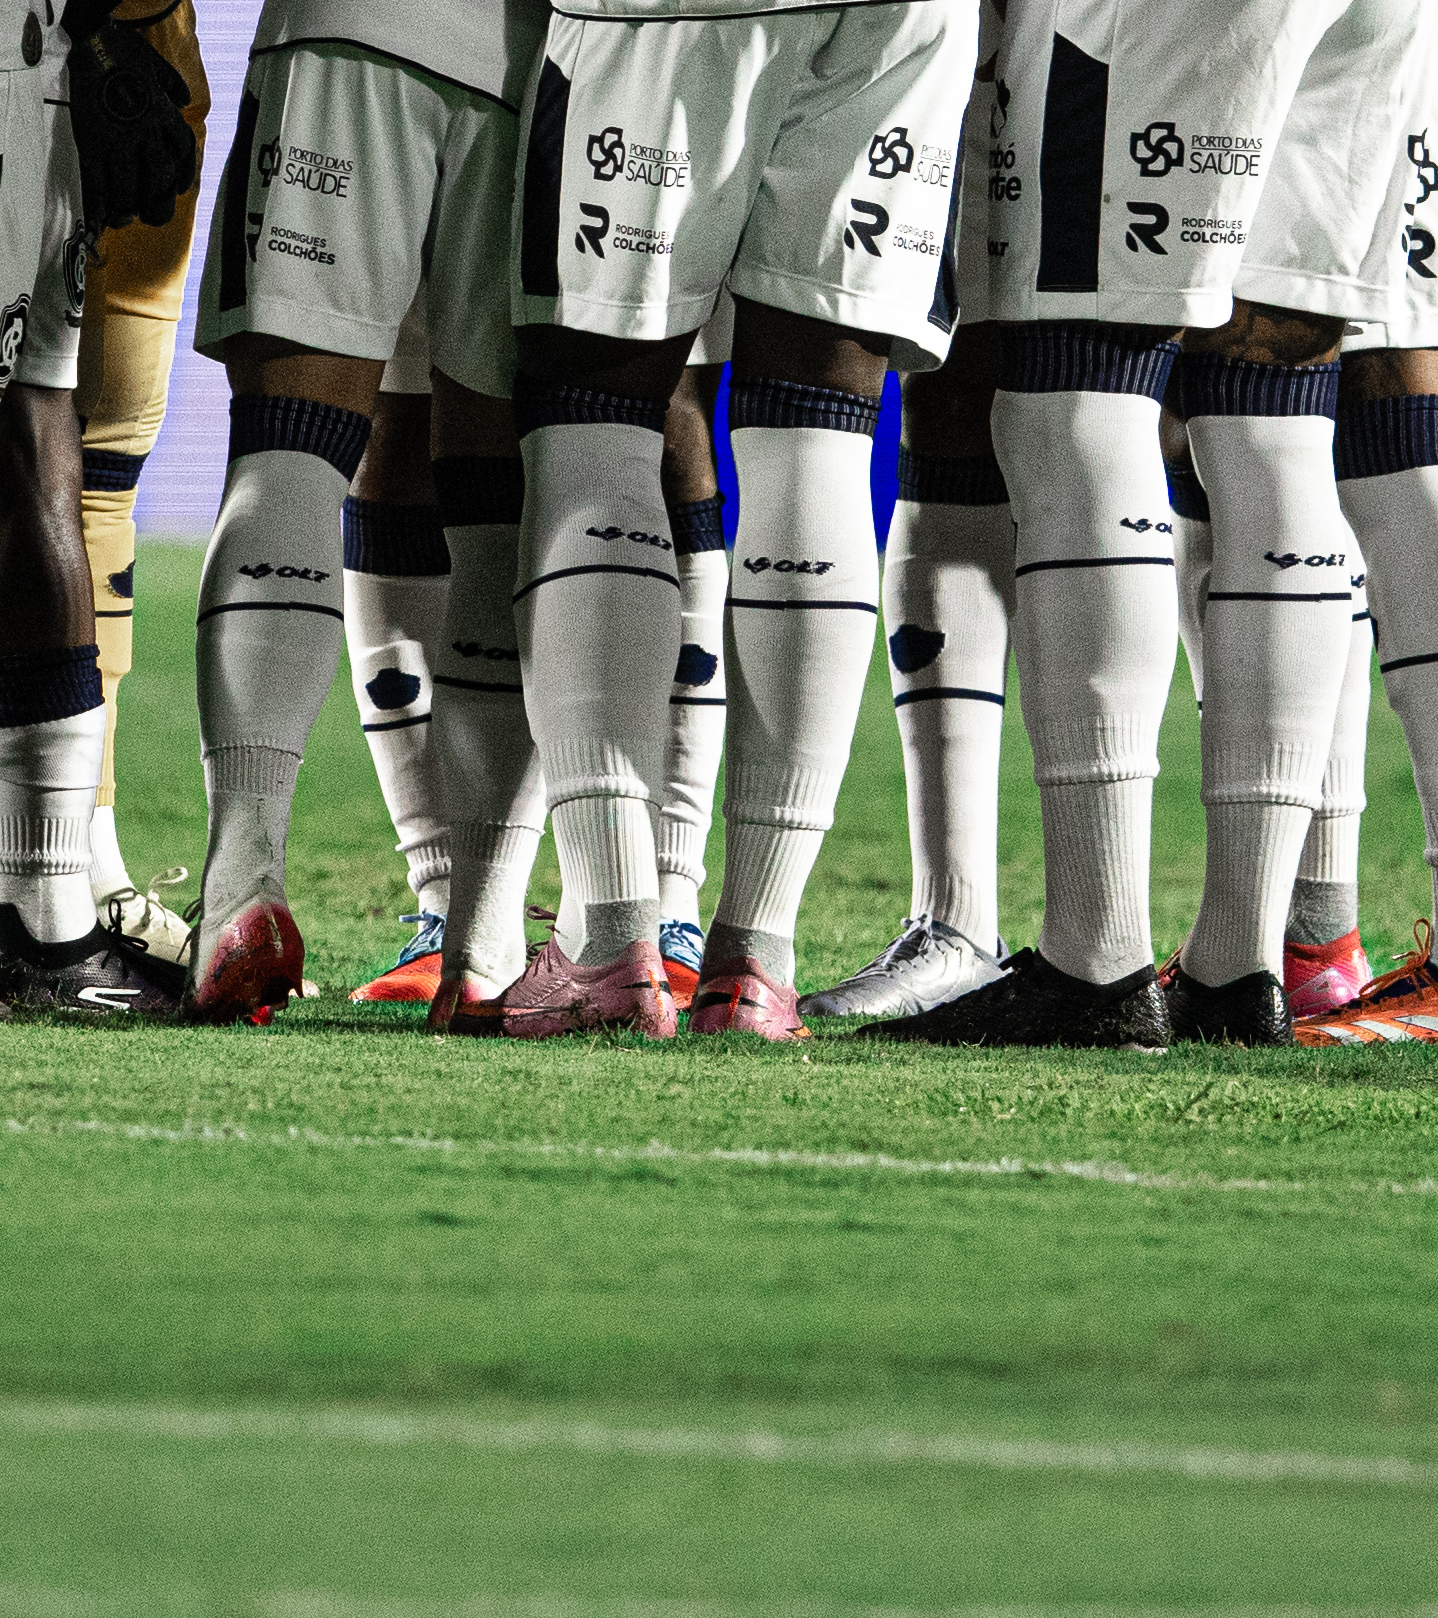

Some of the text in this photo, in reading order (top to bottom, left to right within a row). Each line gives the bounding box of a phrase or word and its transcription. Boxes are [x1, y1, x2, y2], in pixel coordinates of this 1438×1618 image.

[629, 143, 663, 161] PORTO
[1191, 135, 1262, 149] PORTO DIAS
[288, 146, 354, 172] PORTO DIAS
[1189, 150, 1260, 176] SAÚDE
[283, 163, 350, 198] SAÚDE
[625, 160, 688, 188] SAÚDE
[270, 226, 326, 248] RODRIGUES
[1181, 218, 1243, 230] RODRIGUES
[268, 239, 336, 265] COLCHÕES
